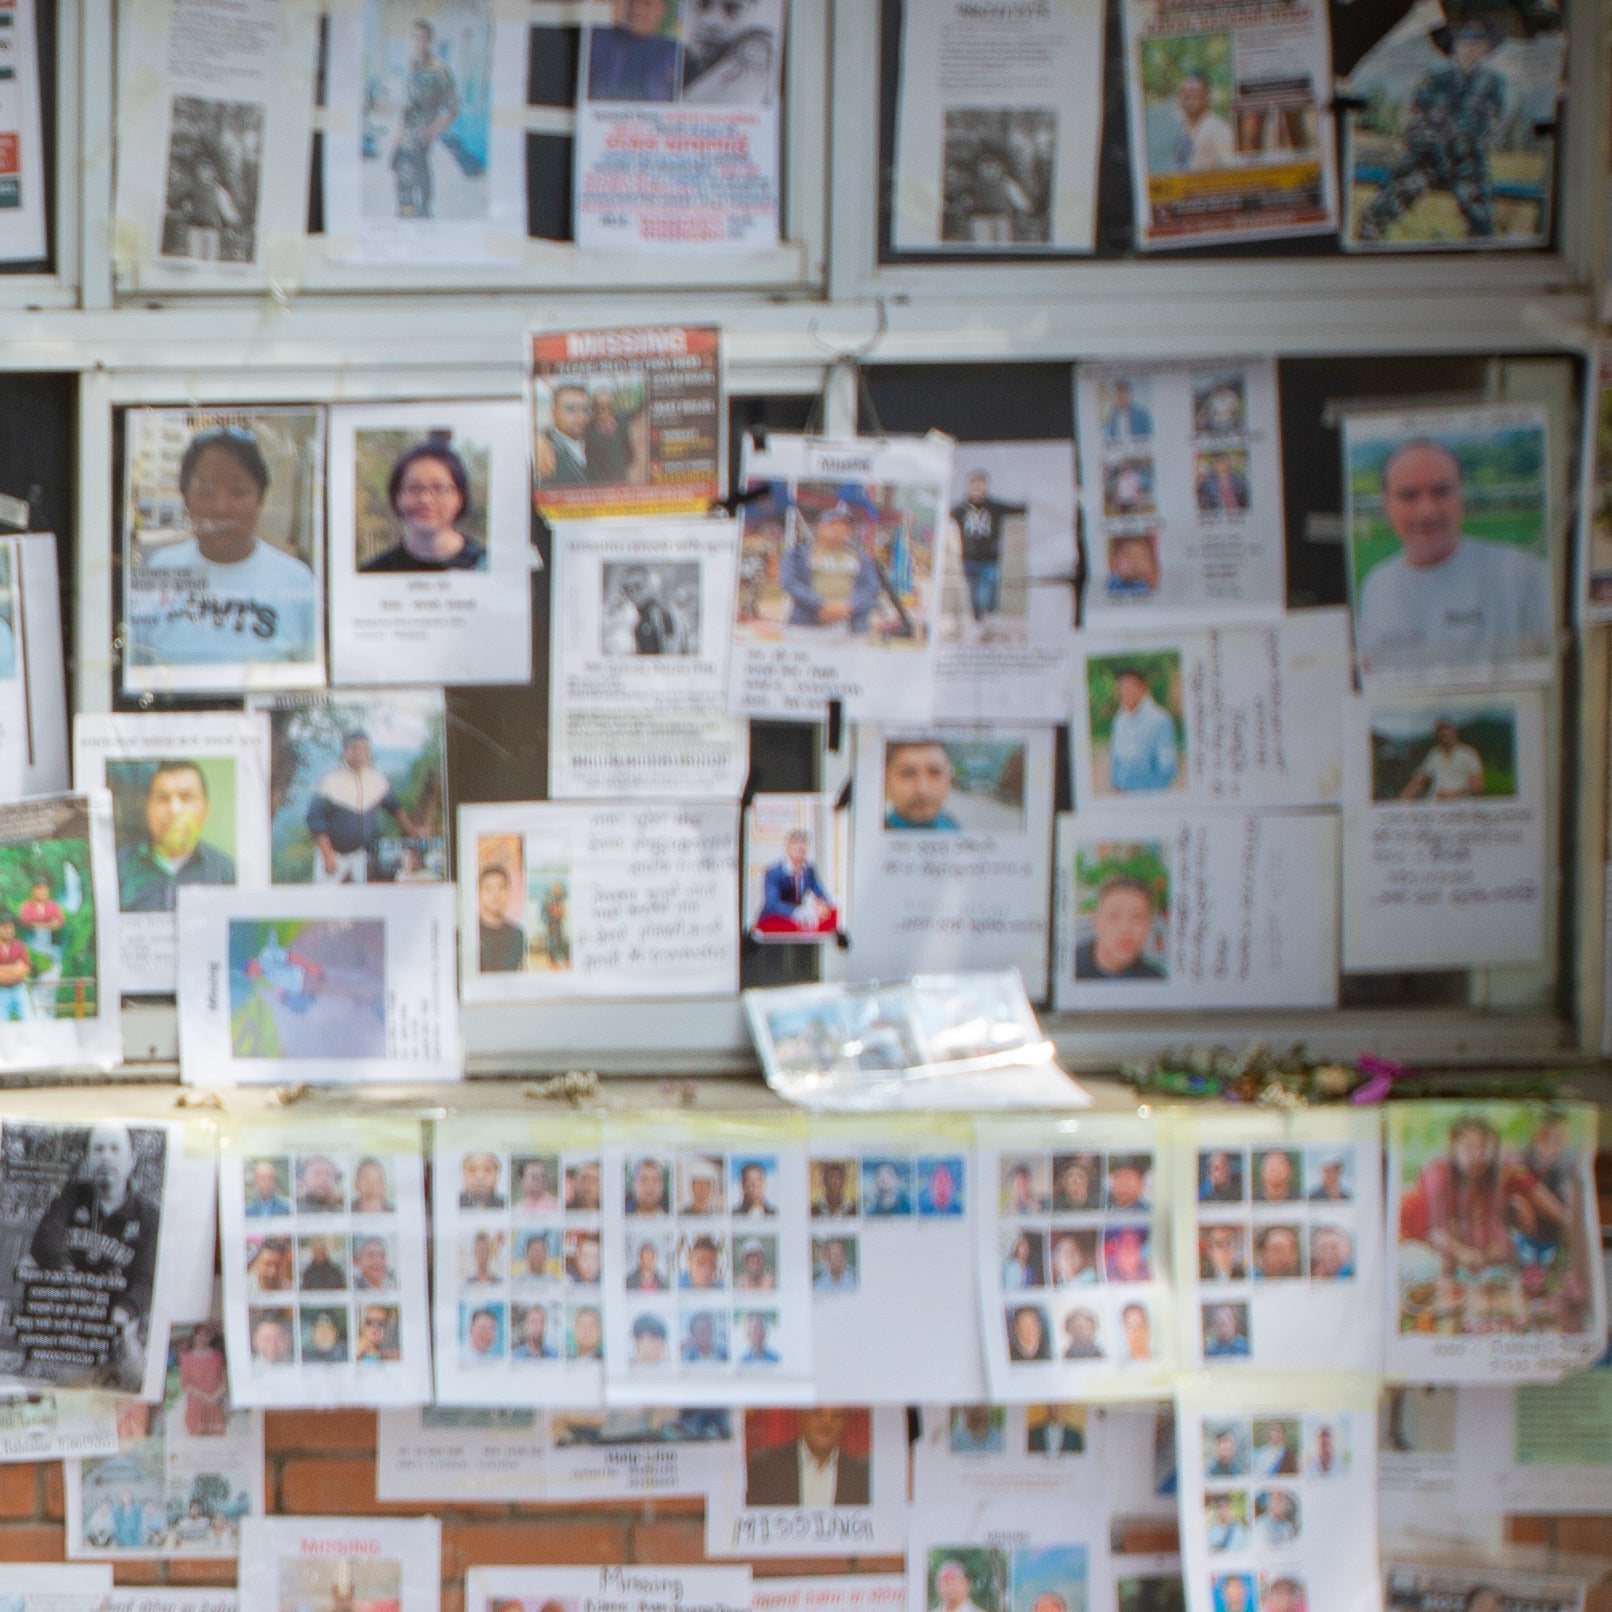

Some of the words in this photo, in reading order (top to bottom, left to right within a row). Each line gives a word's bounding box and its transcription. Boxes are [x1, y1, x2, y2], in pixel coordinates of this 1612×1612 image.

[732, 1509, 874, 1545] MISSING
[302, 1538, 381, 1555] MISSING
[600, 1565, 685, 1602] Missing
